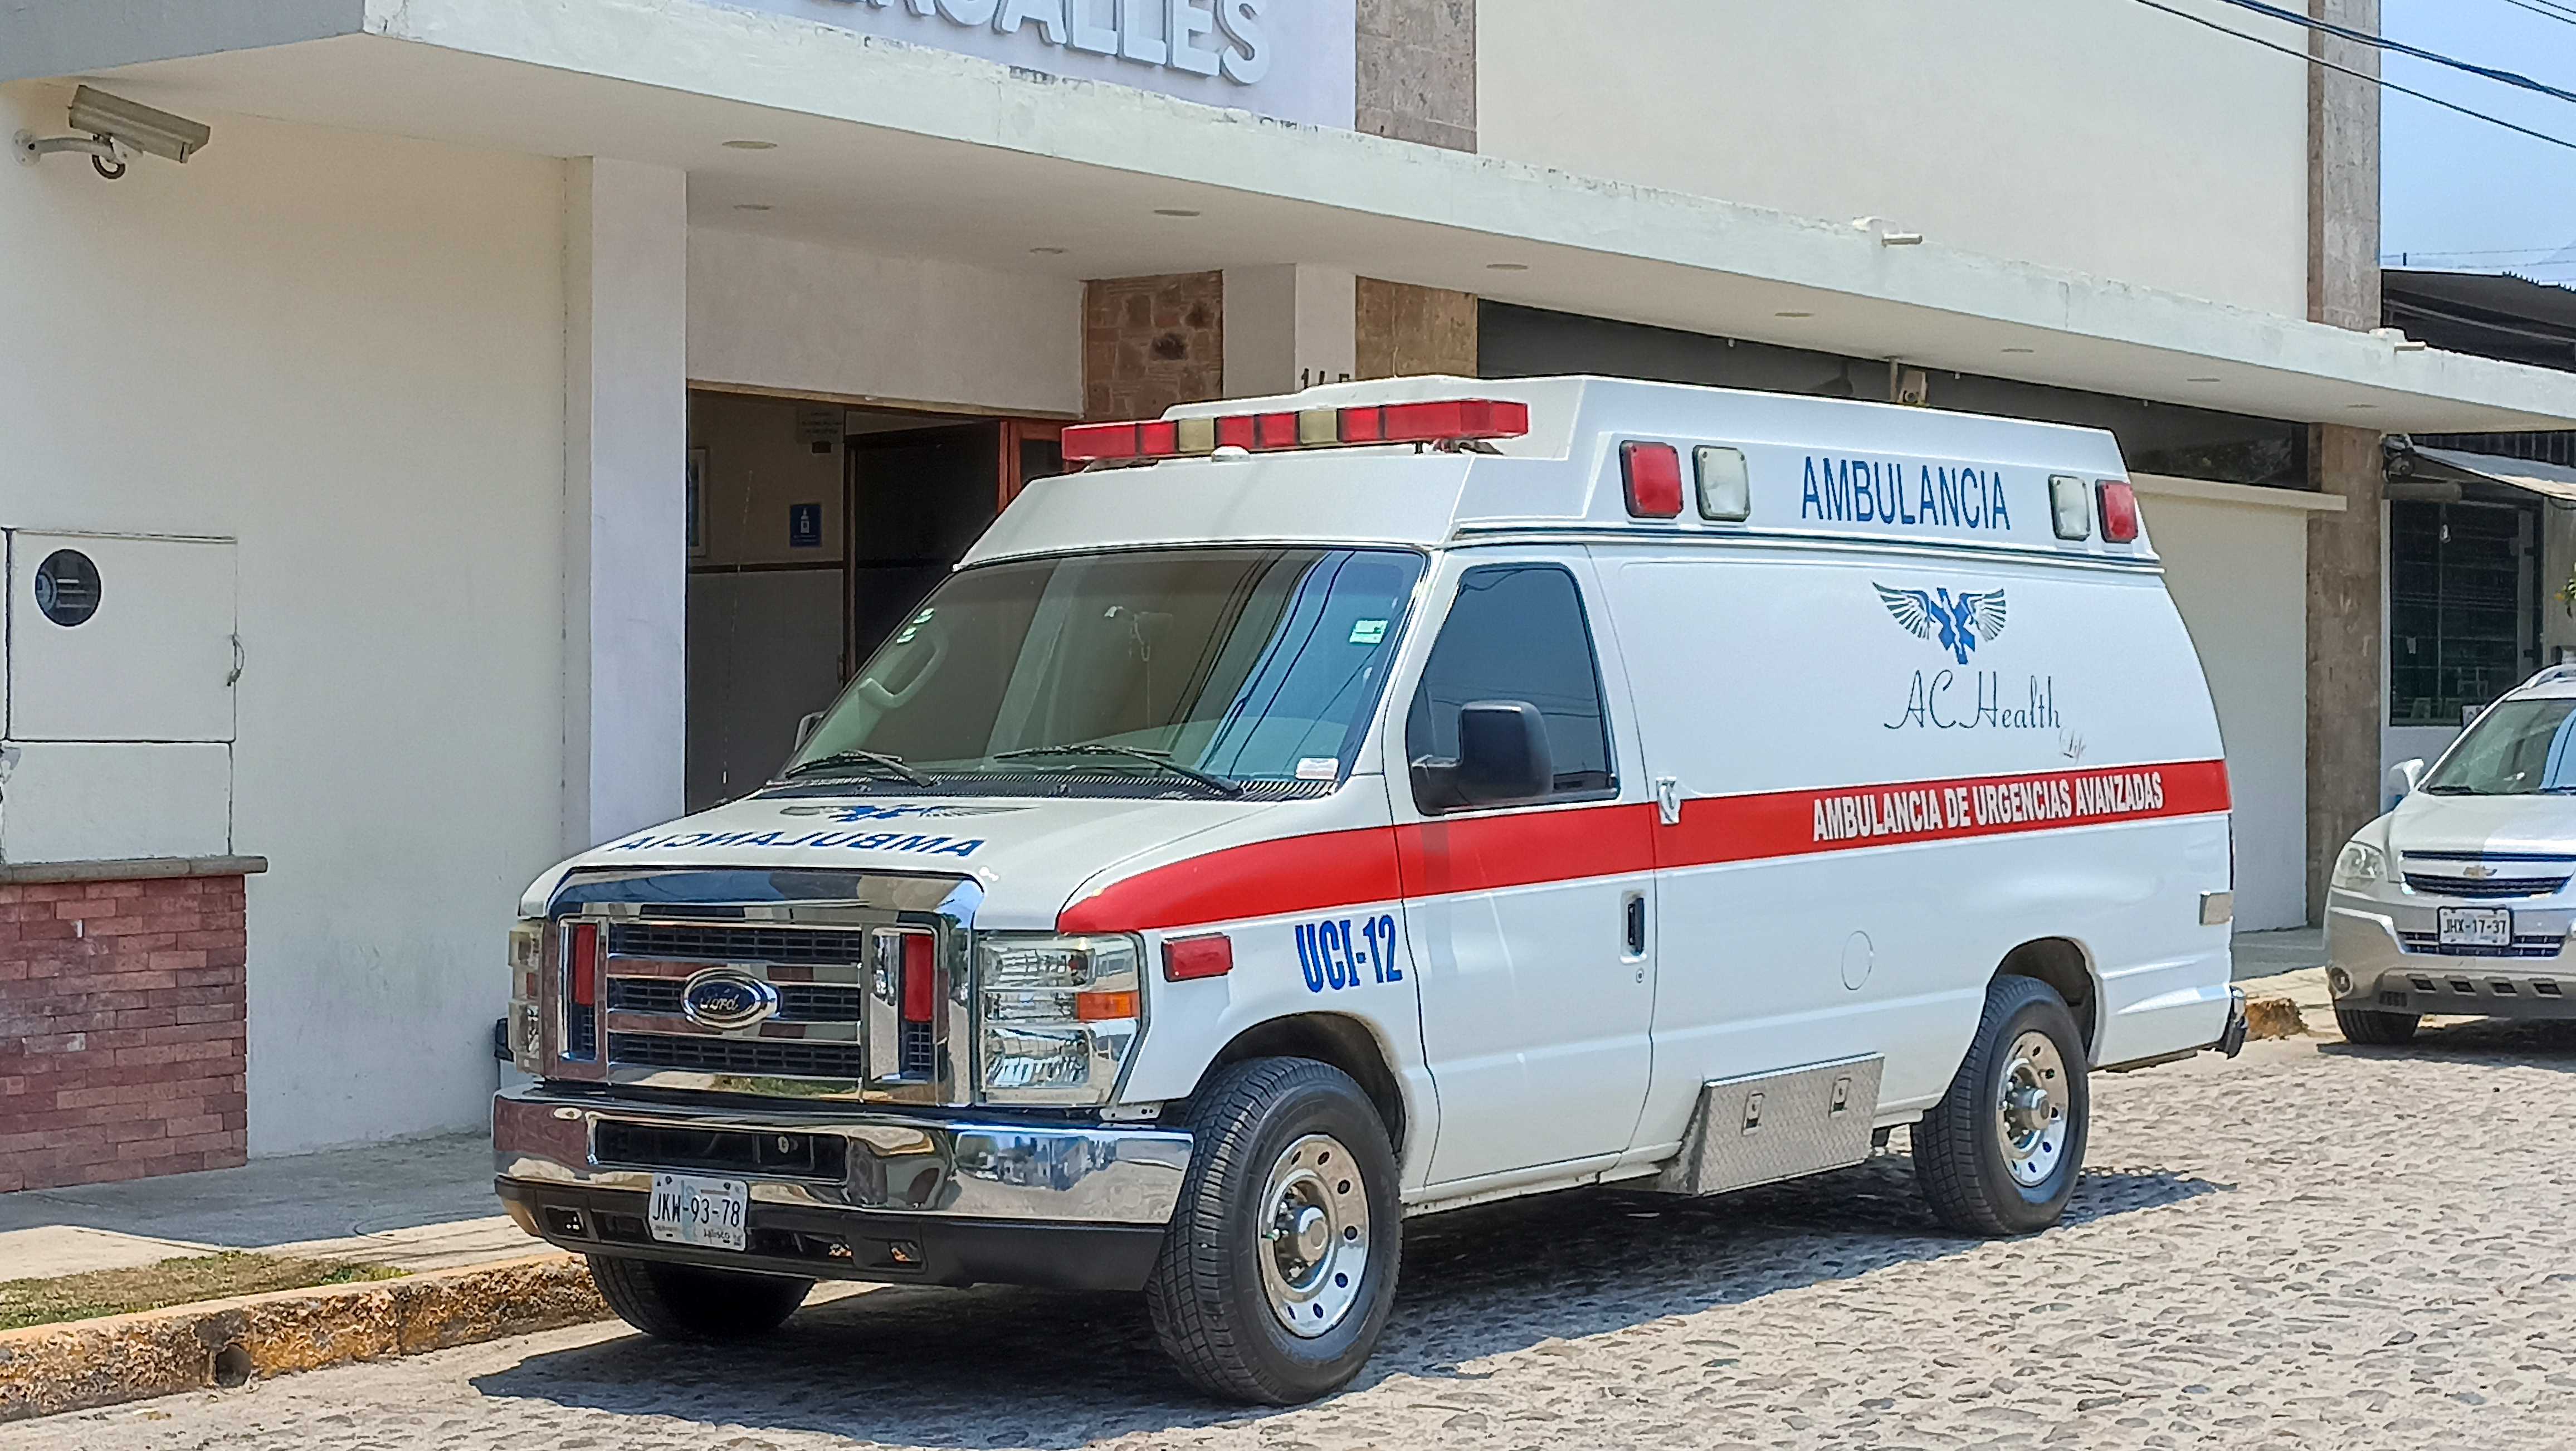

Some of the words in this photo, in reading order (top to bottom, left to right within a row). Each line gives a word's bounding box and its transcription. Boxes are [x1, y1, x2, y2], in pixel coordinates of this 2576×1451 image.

[1802, 456, 2011, 530] AMBULANCIA
[1959, 670, 2061, 729] Health
[1813, 789, 1943, 841] AMBULANCIA
[1944, 787, 1971, 829] DE
[1972, 779, 2072, 825] URGENCIAS
[2075, 771, 2164, 816] AVANZADAS
[1295, 914, 1403, 993] UCI-12
[652, 1192, 741, 1227] JKW-93-78
